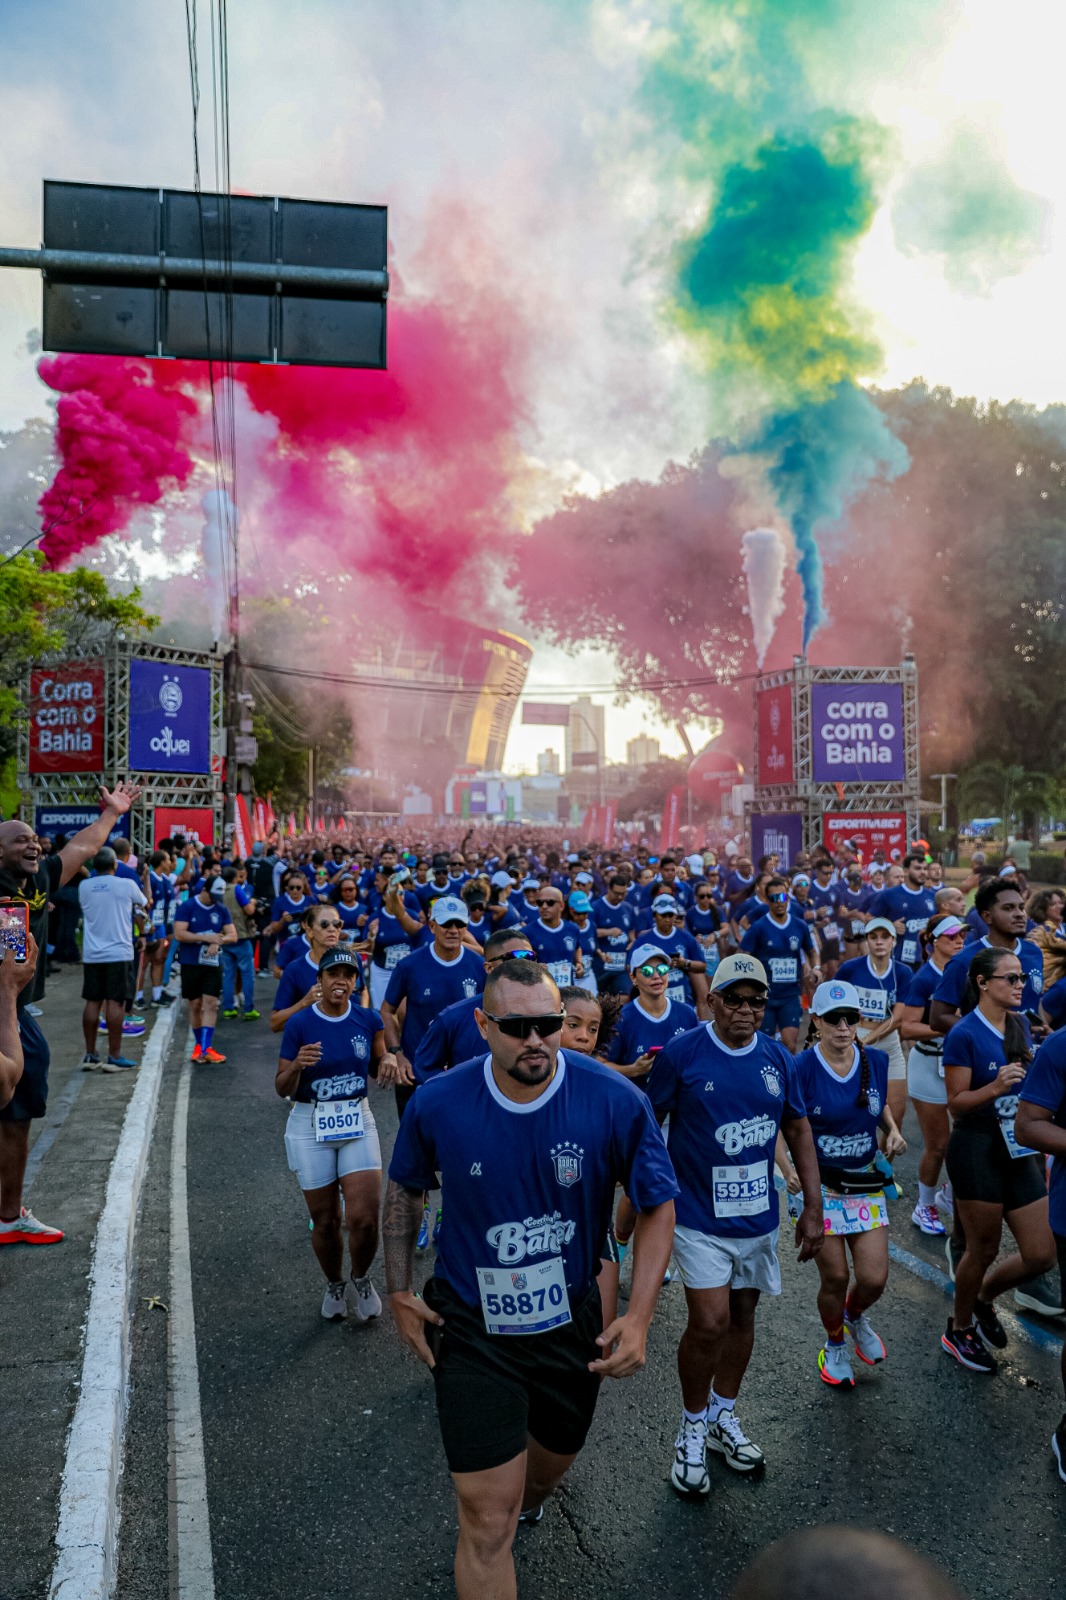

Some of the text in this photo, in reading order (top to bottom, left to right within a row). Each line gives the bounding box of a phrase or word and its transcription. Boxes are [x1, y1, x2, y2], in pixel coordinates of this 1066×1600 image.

[40, 679, 93, 702] Corra
[36, 705, 96, 727] com o
[827, 702, 888, 719] corra
[39, 727, 93, 753] Bahia
[821, 723, 895, 740] com o
[826, 742, 892, 764] Bahia
[734, 961, 754, 973] NYC
[318, 1112, 360, 1130] 50507
[717, 1177, 767, 1198] 59135
[486, 1283, 563, 1316] 58870
